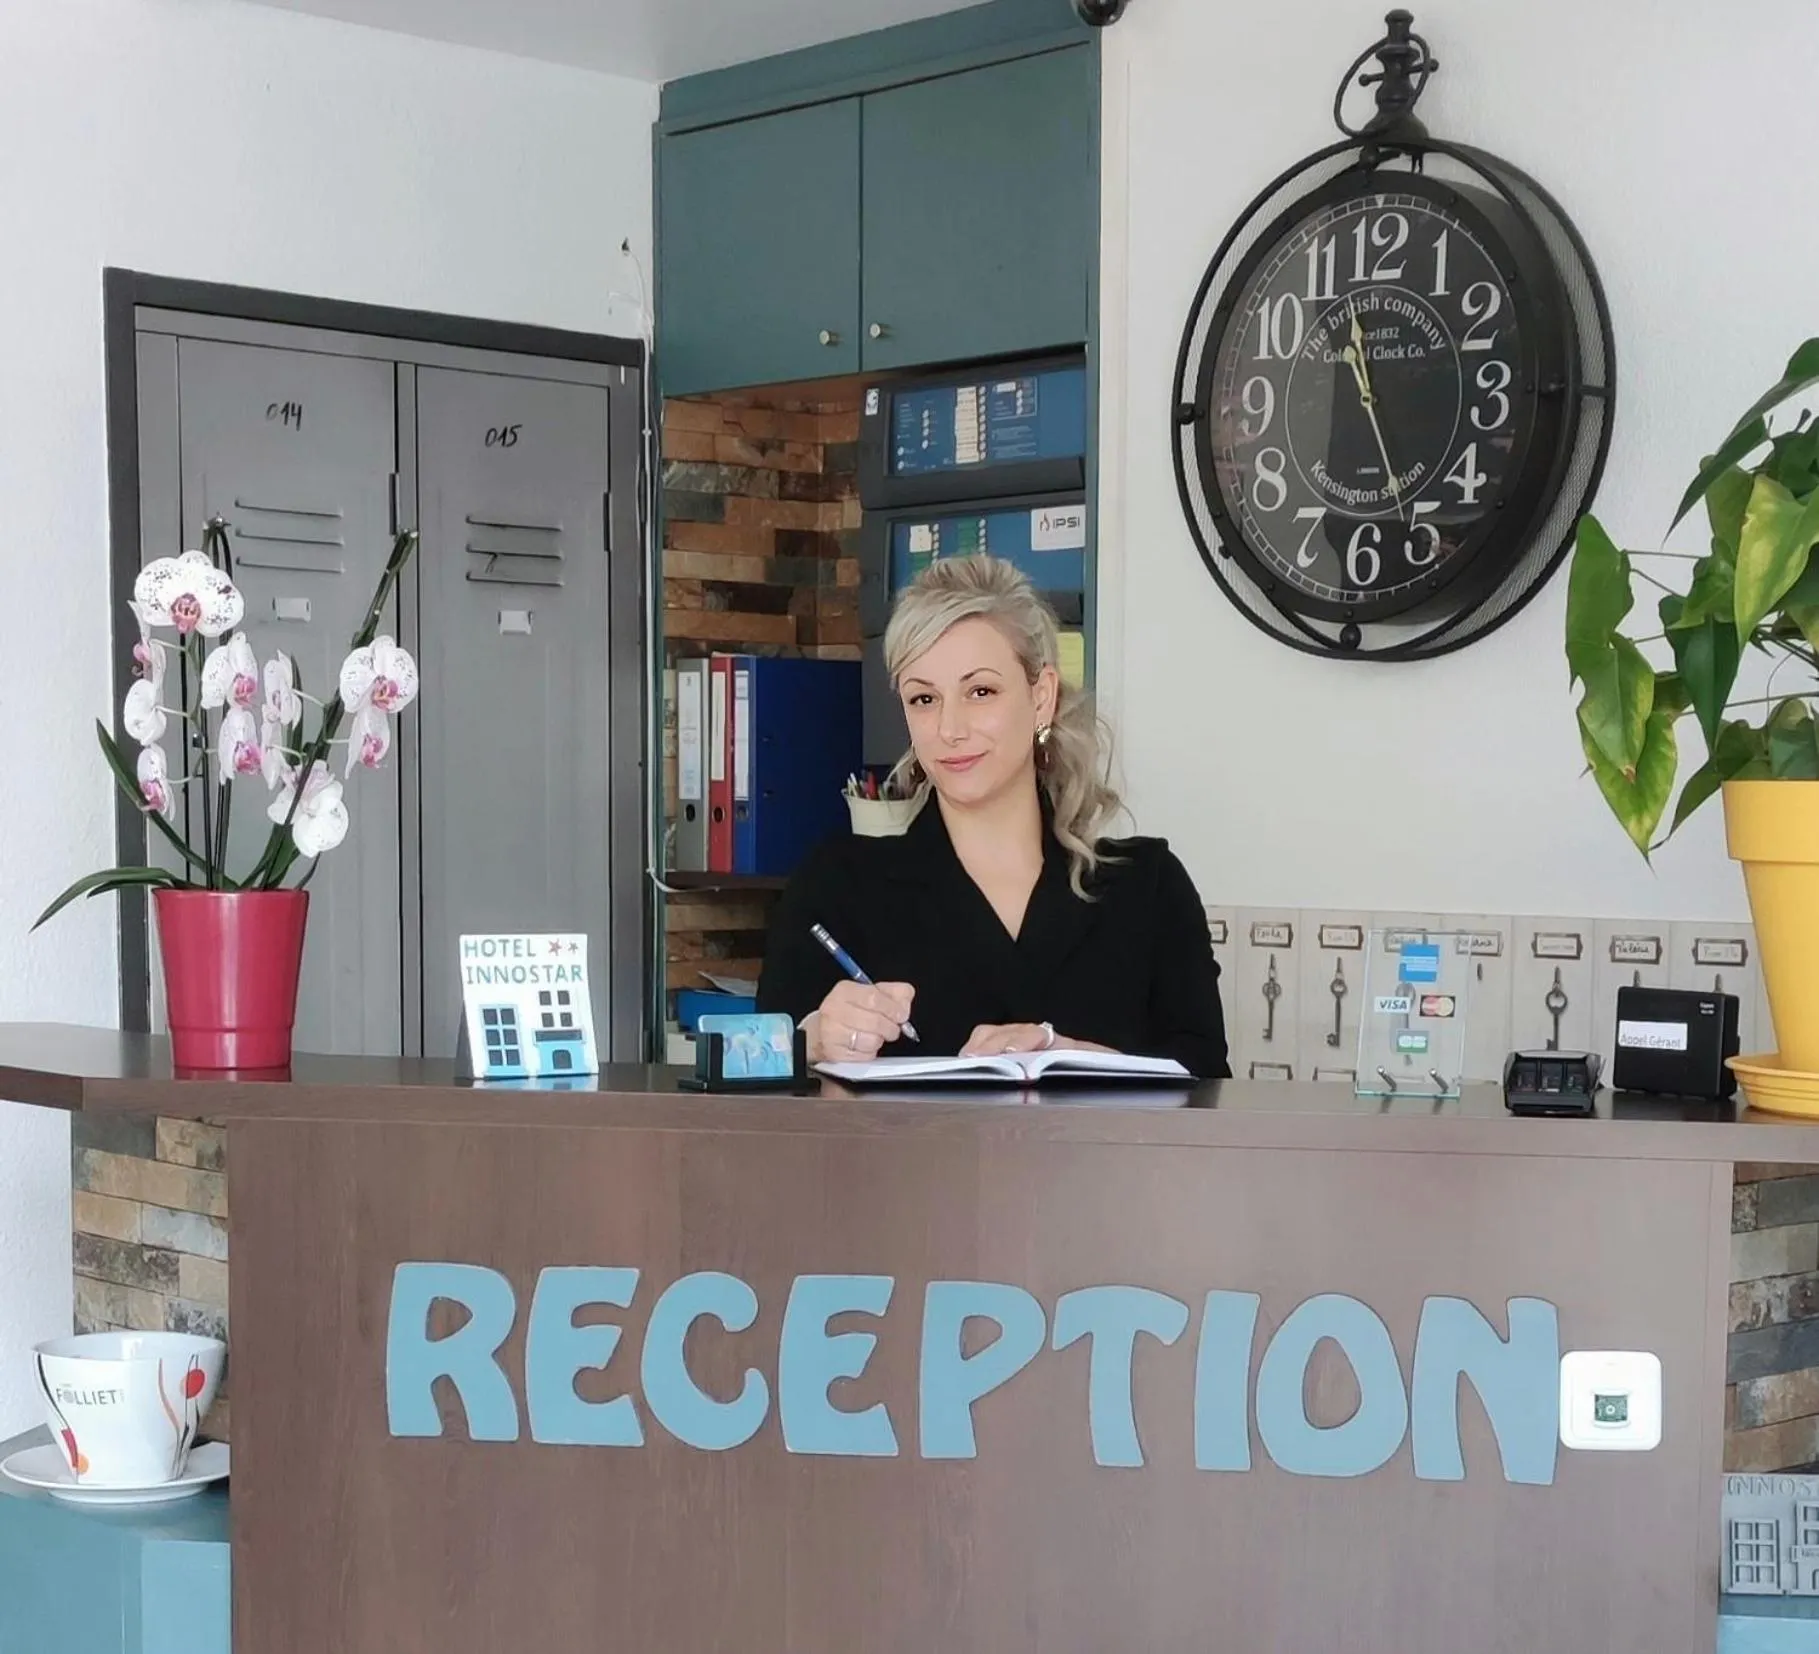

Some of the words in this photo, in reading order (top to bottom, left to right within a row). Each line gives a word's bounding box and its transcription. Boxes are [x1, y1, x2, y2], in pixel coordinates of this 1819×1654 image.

[1301, 234, 1339, 301] 11
[1348, 212, 1410, 282] 12
[1429, 228, 1450, 297] 1
[1252, 292, 1304, 361] 10
[1301, 327, 1328, 361] The
[1384, 297, 1446, 350] company
[1461, 281, 1501, 351] 2
[1373, 345, 1405, 361] Clock
[1407, 343, 1426, 359] Co.
[266, 401, 303, 430] 014
[1240, 375, 1275, 437] 9
[1470, 360, 1512, 431] 3
[484, 424, 523, 448] 015
[1252, 446, 1288, 511] 8
[1310, 460, 1378, 506] Kensington
[1381, 461, 1426, 500] sttion
[1443, 442, 1487, 504] 4
[1292, 506, 1328, 568] 7
[1346, 522, 1381, 586] 6
[1404, 501, 1442, 565] 5
[463, 938, 537, 959] HOTEL
[465, 964, 584, 985] INNOSTAR
[1379, 999, 1408, 1010] VISA
[386, 1262, 1561, 1486] RECEPTION
